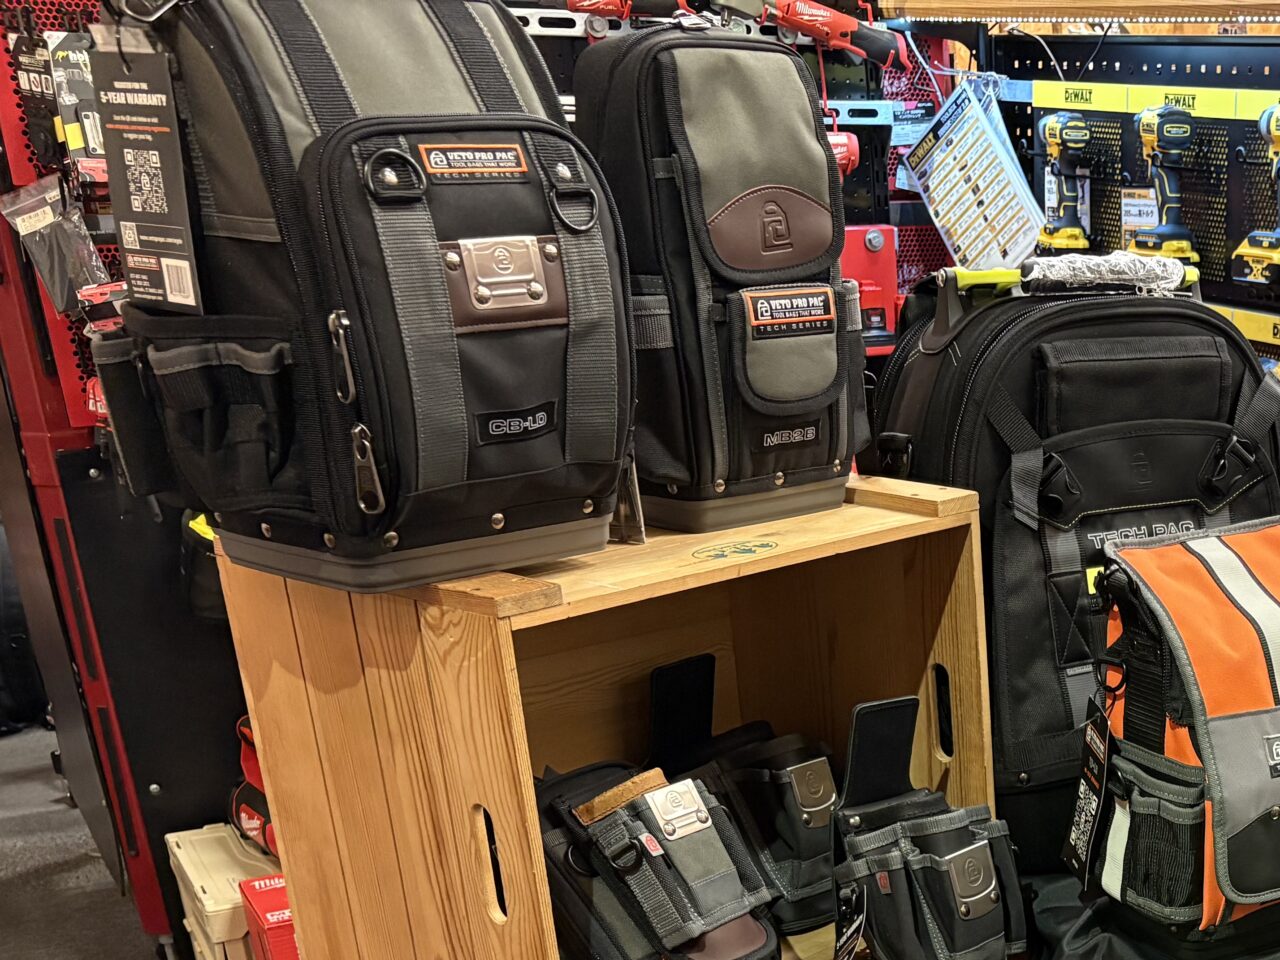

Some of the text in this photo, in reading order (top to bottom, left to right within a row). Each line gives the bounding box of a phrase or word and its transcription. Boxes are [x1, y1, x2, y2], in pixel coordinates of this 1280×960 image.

[816, 23, 831, 33] FUEL
[100, 91, 167, 107] 5-YEAR WARRANTY
[446, 151, 474, 160] VETO
[474, 151, 494, 160] PRO
[769, 299, 791, 309] VETO
[791, 298, 808, 308] PRO
[760, 321, 828, 332] TECH SERIES
[489, 412, 547, 434] CB-LD
[763, 426, 815, 446] MB2B
[1088, 521, 1194, 549] TECH PAC
